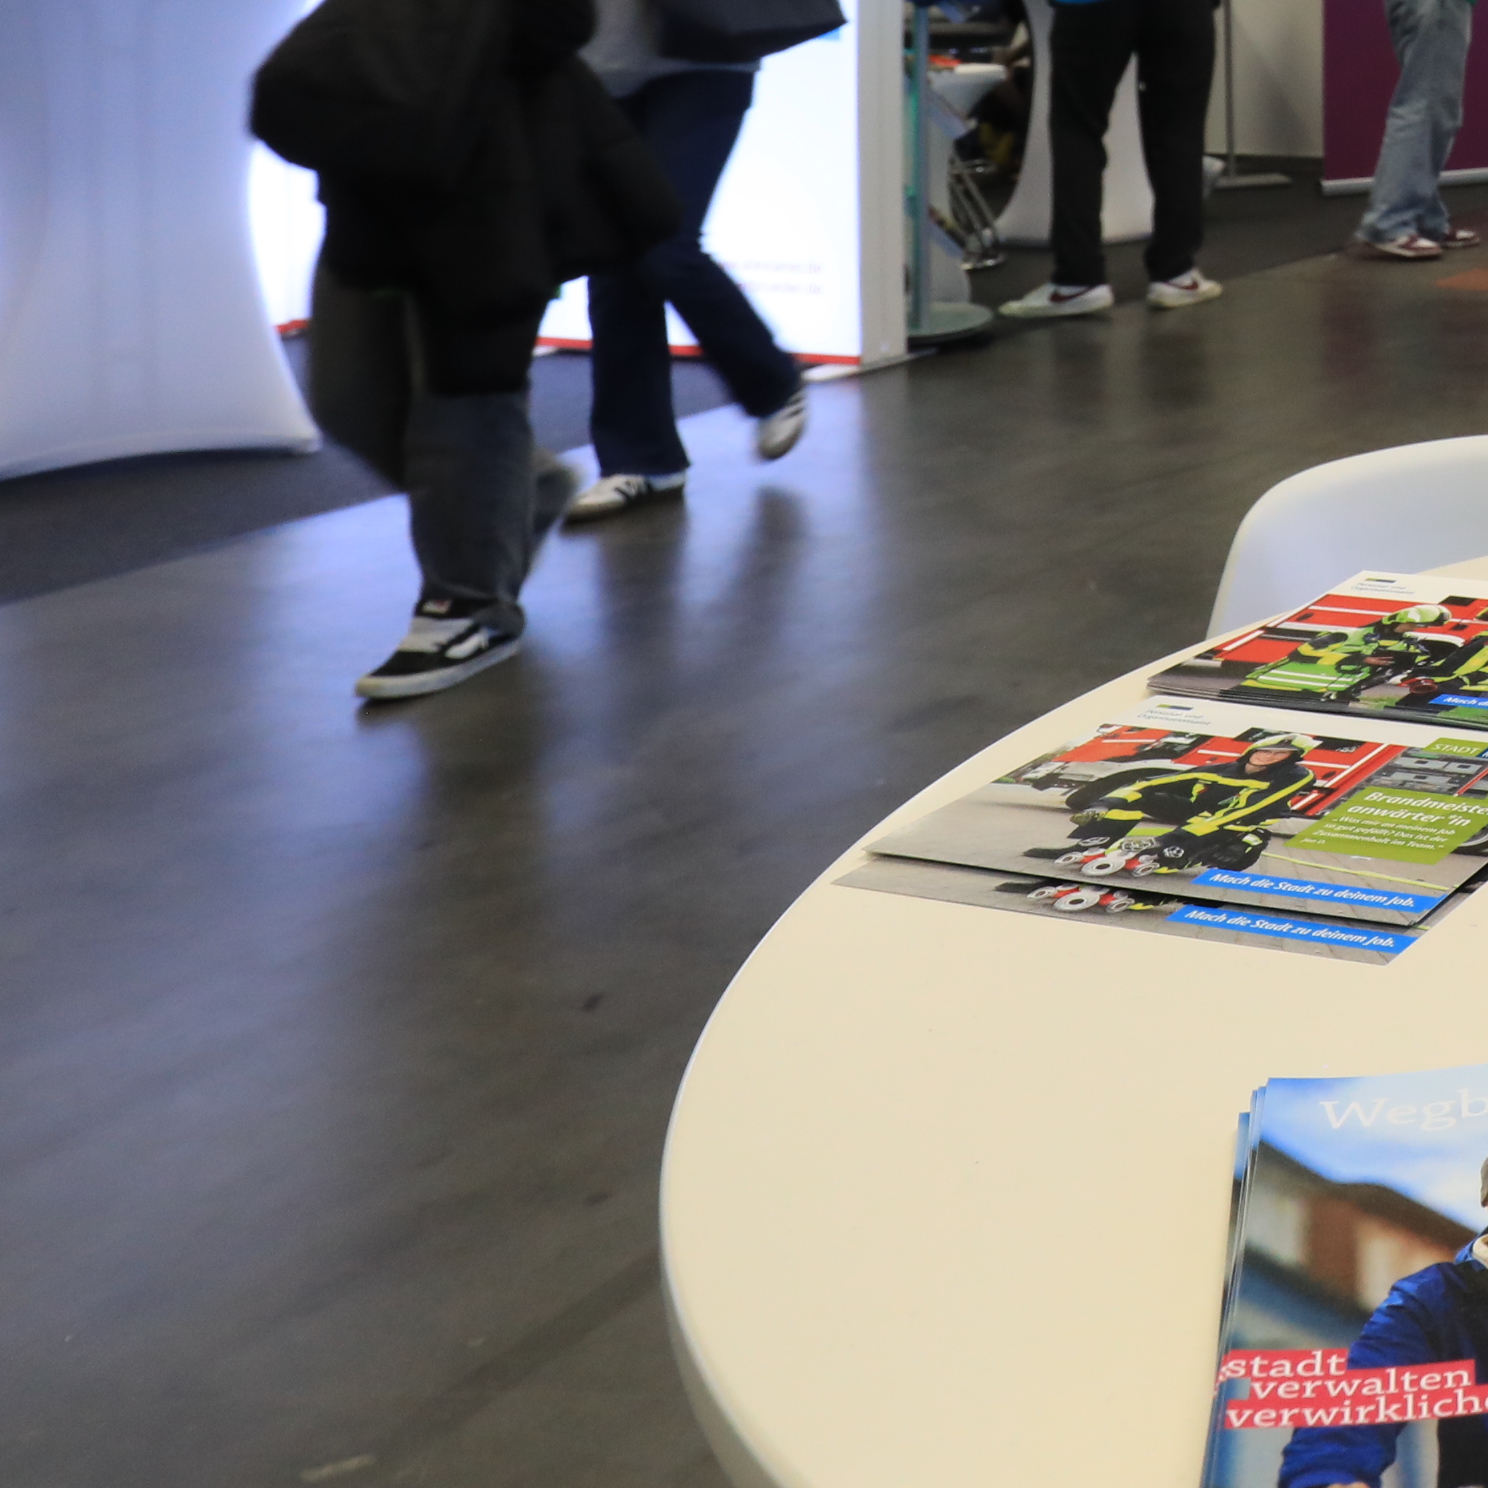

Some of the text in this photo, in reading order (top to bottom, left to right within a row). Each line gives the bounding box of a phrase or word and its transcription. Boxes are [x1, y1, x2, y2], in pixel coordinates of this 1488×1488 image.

[1444, 695, 1475, 707] Mach
[1431, 742, 1481, 756] STADT
[1347, 804, 1447, 824] anwärter
[1313, 829, 1391, 844] Zusammenhalt
[1394, 830, 1414, 839] Das
[1429, 835, 1449, 843] der
[1395, 823, 1438, 833] meinem
[1211, 873, 1415, 909] Mach die Stadt zu deinem Job.
[1186, 909, 1395, 949] Mach die Stadt zu deinem Job.
[1227, 1350, 1346, 1378] stadt
[1251, 1367, 1471, 1400] verwalten
